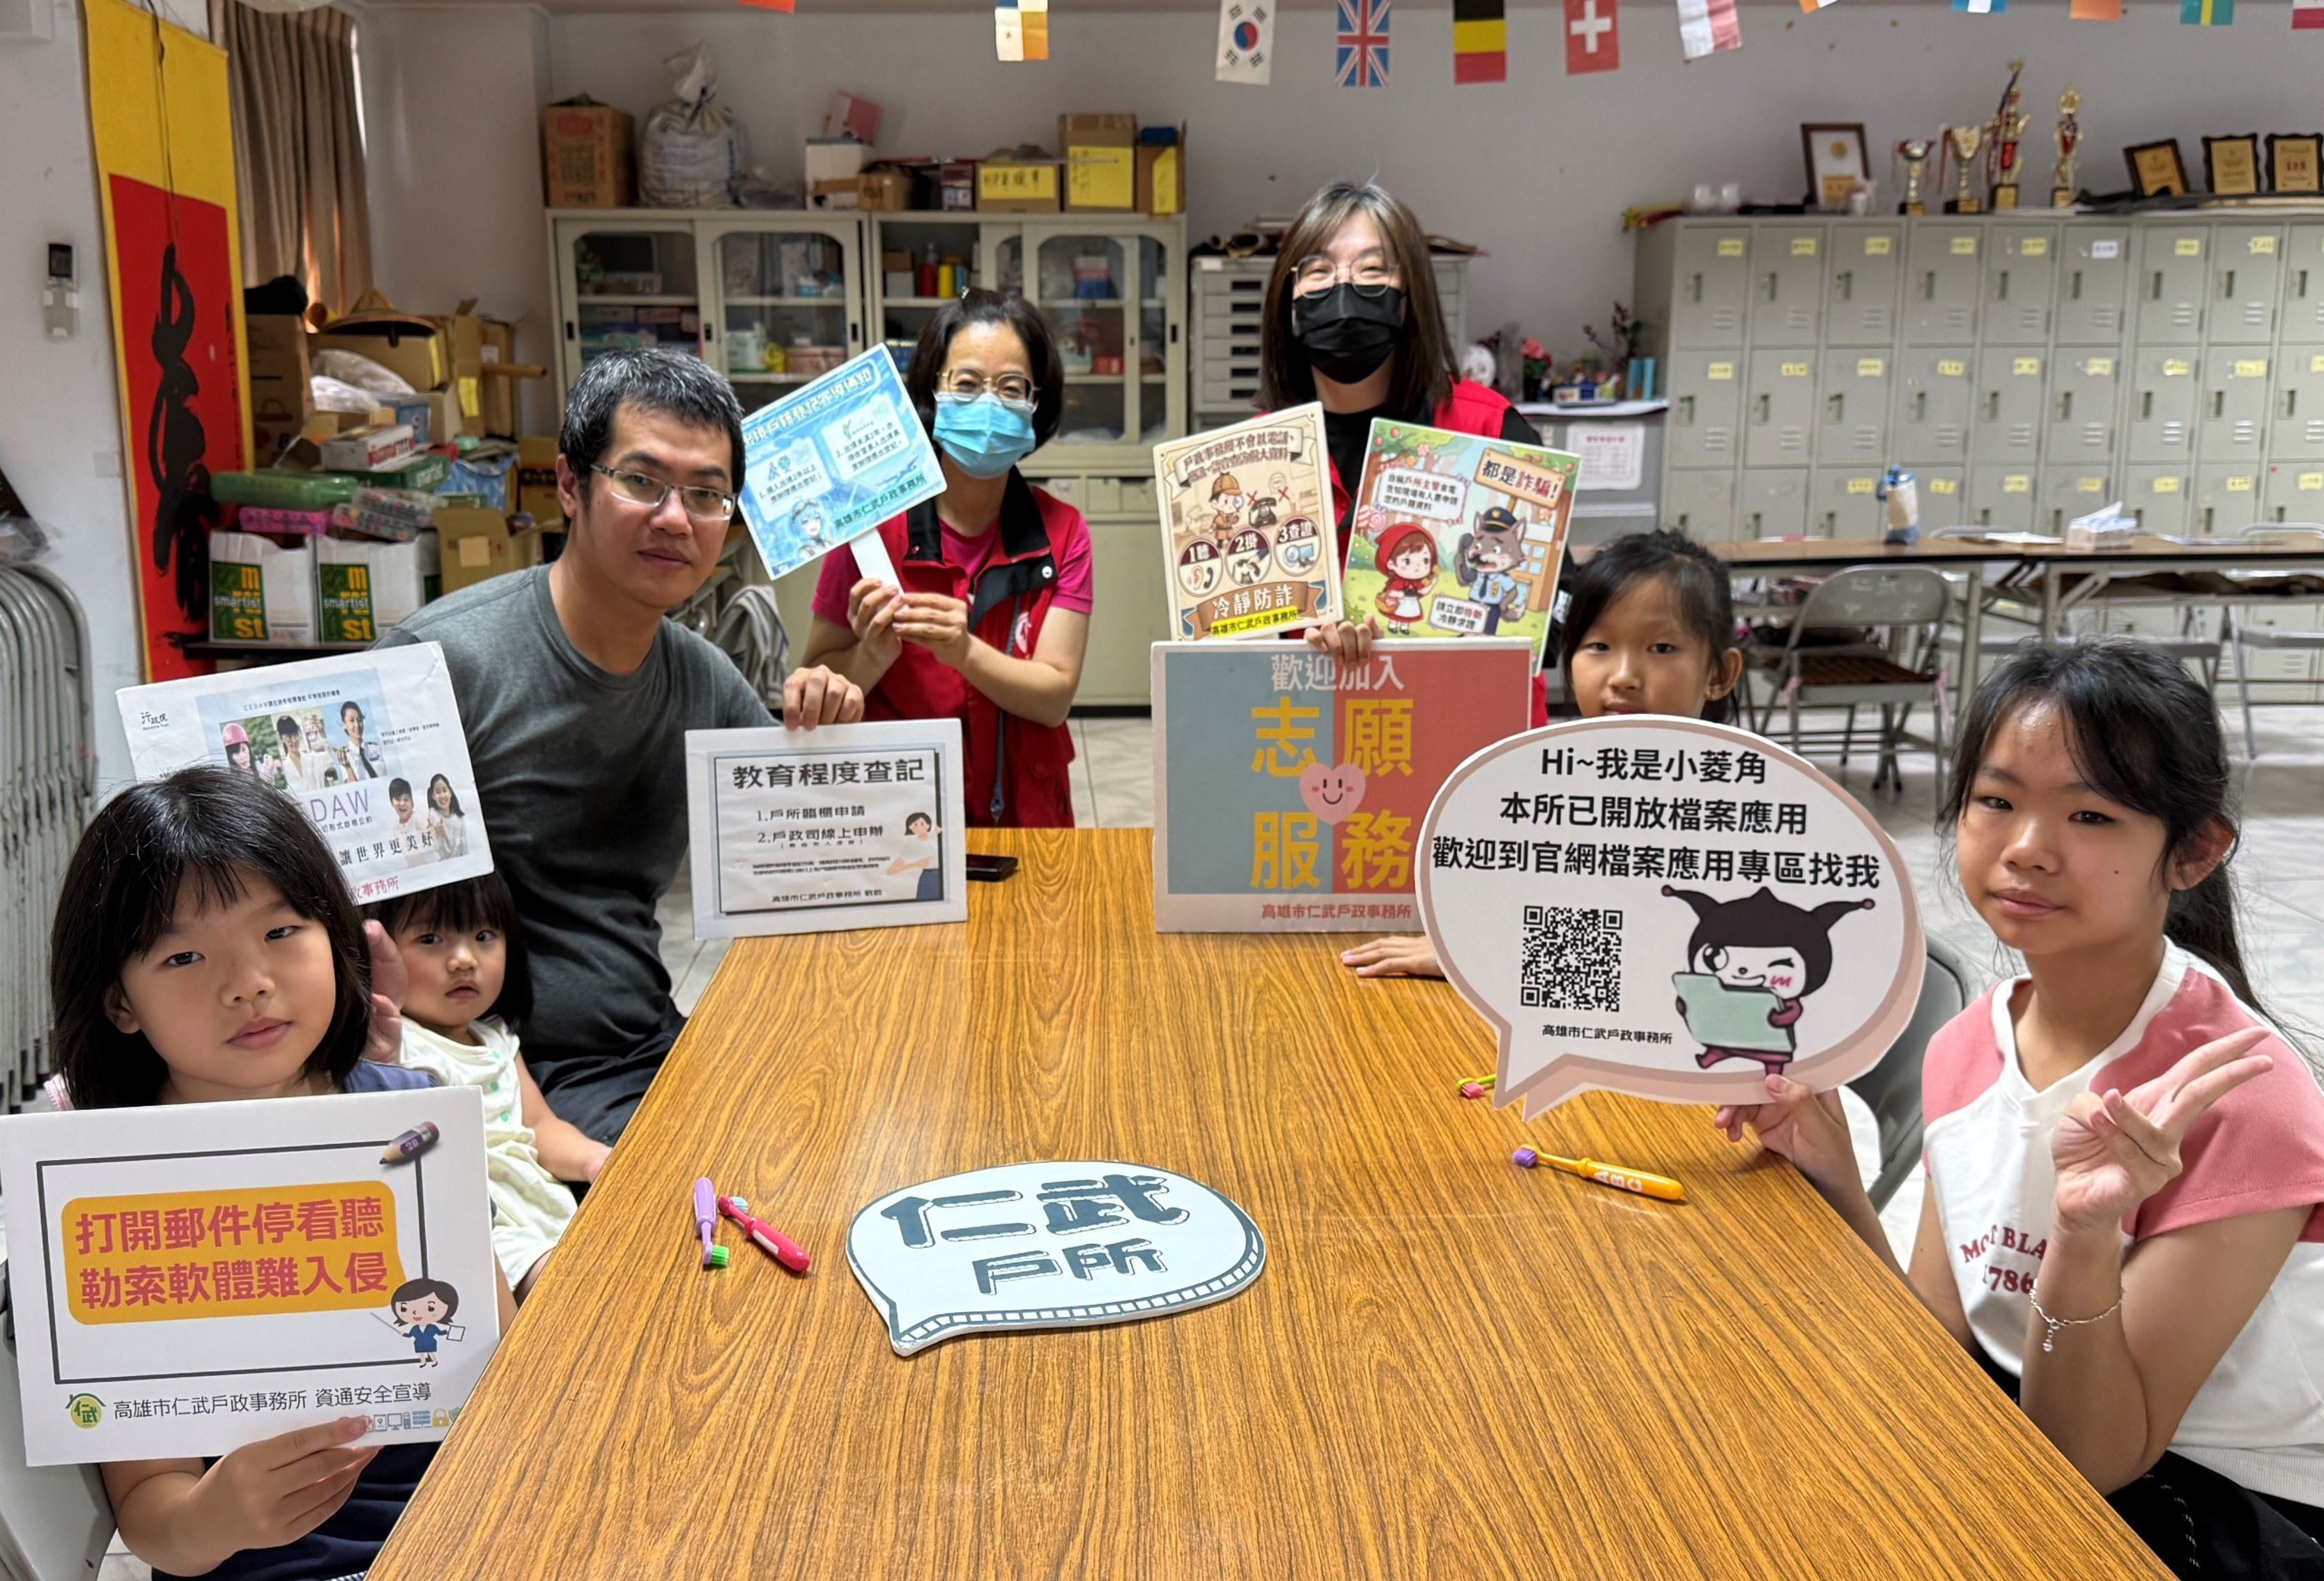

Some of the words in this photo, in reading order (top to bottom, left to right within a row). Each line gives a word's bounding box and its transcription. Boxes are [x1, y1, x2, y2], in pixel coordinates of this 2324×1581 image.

[833, 473, 927, 530] 高雄市仁武戶政事務所
[213, 594, 261, 608] smartist
[323, 596, 369, 610] smartist
[1213, 584, 1293, 619] 冷靜防詐
[1212, 610, 1298, 635] 高雄市仁武戶政事務所
[1270, 654, 1404, 693] 歡迎加入
[1251, 697, 1414, 778] 志願
[732, 758, 925, 789] 教育程度查記
[1541, 747, 1767, 785] Hi~我是小菱角
[300, 789, 369, 823] DAW
[1499, 792, 1808, 835] 本所已開放檔案應用
[339, 831, 433, 866] 讓世界更美好
[1251, 808, 1413, 890] 服務
[1432, 837, 1880, 888] 歡迎到官網檔案應用專區找我
[771, 890, 861, 903] 高雄市仁武戶政事務所
[1261, 903, 1412, 920] 高雄市仁武戶政事務所
[1542, 1024, 1673, 1045] 高雄市仁武戶政事務所
[75, 1196, 384, 1256] 打開郵件停看聽
[881, 1174, 1190, 1249] 仁武
[2001, 1226, 2048, 1260] BLA
[79, 1251, 389, 1310] 勒索軟體難入侵
[113, 1389, 308, 1420] 高雄市仁武戶政事務所
[314, 1381, 433, 1410] 資通安全宣導
